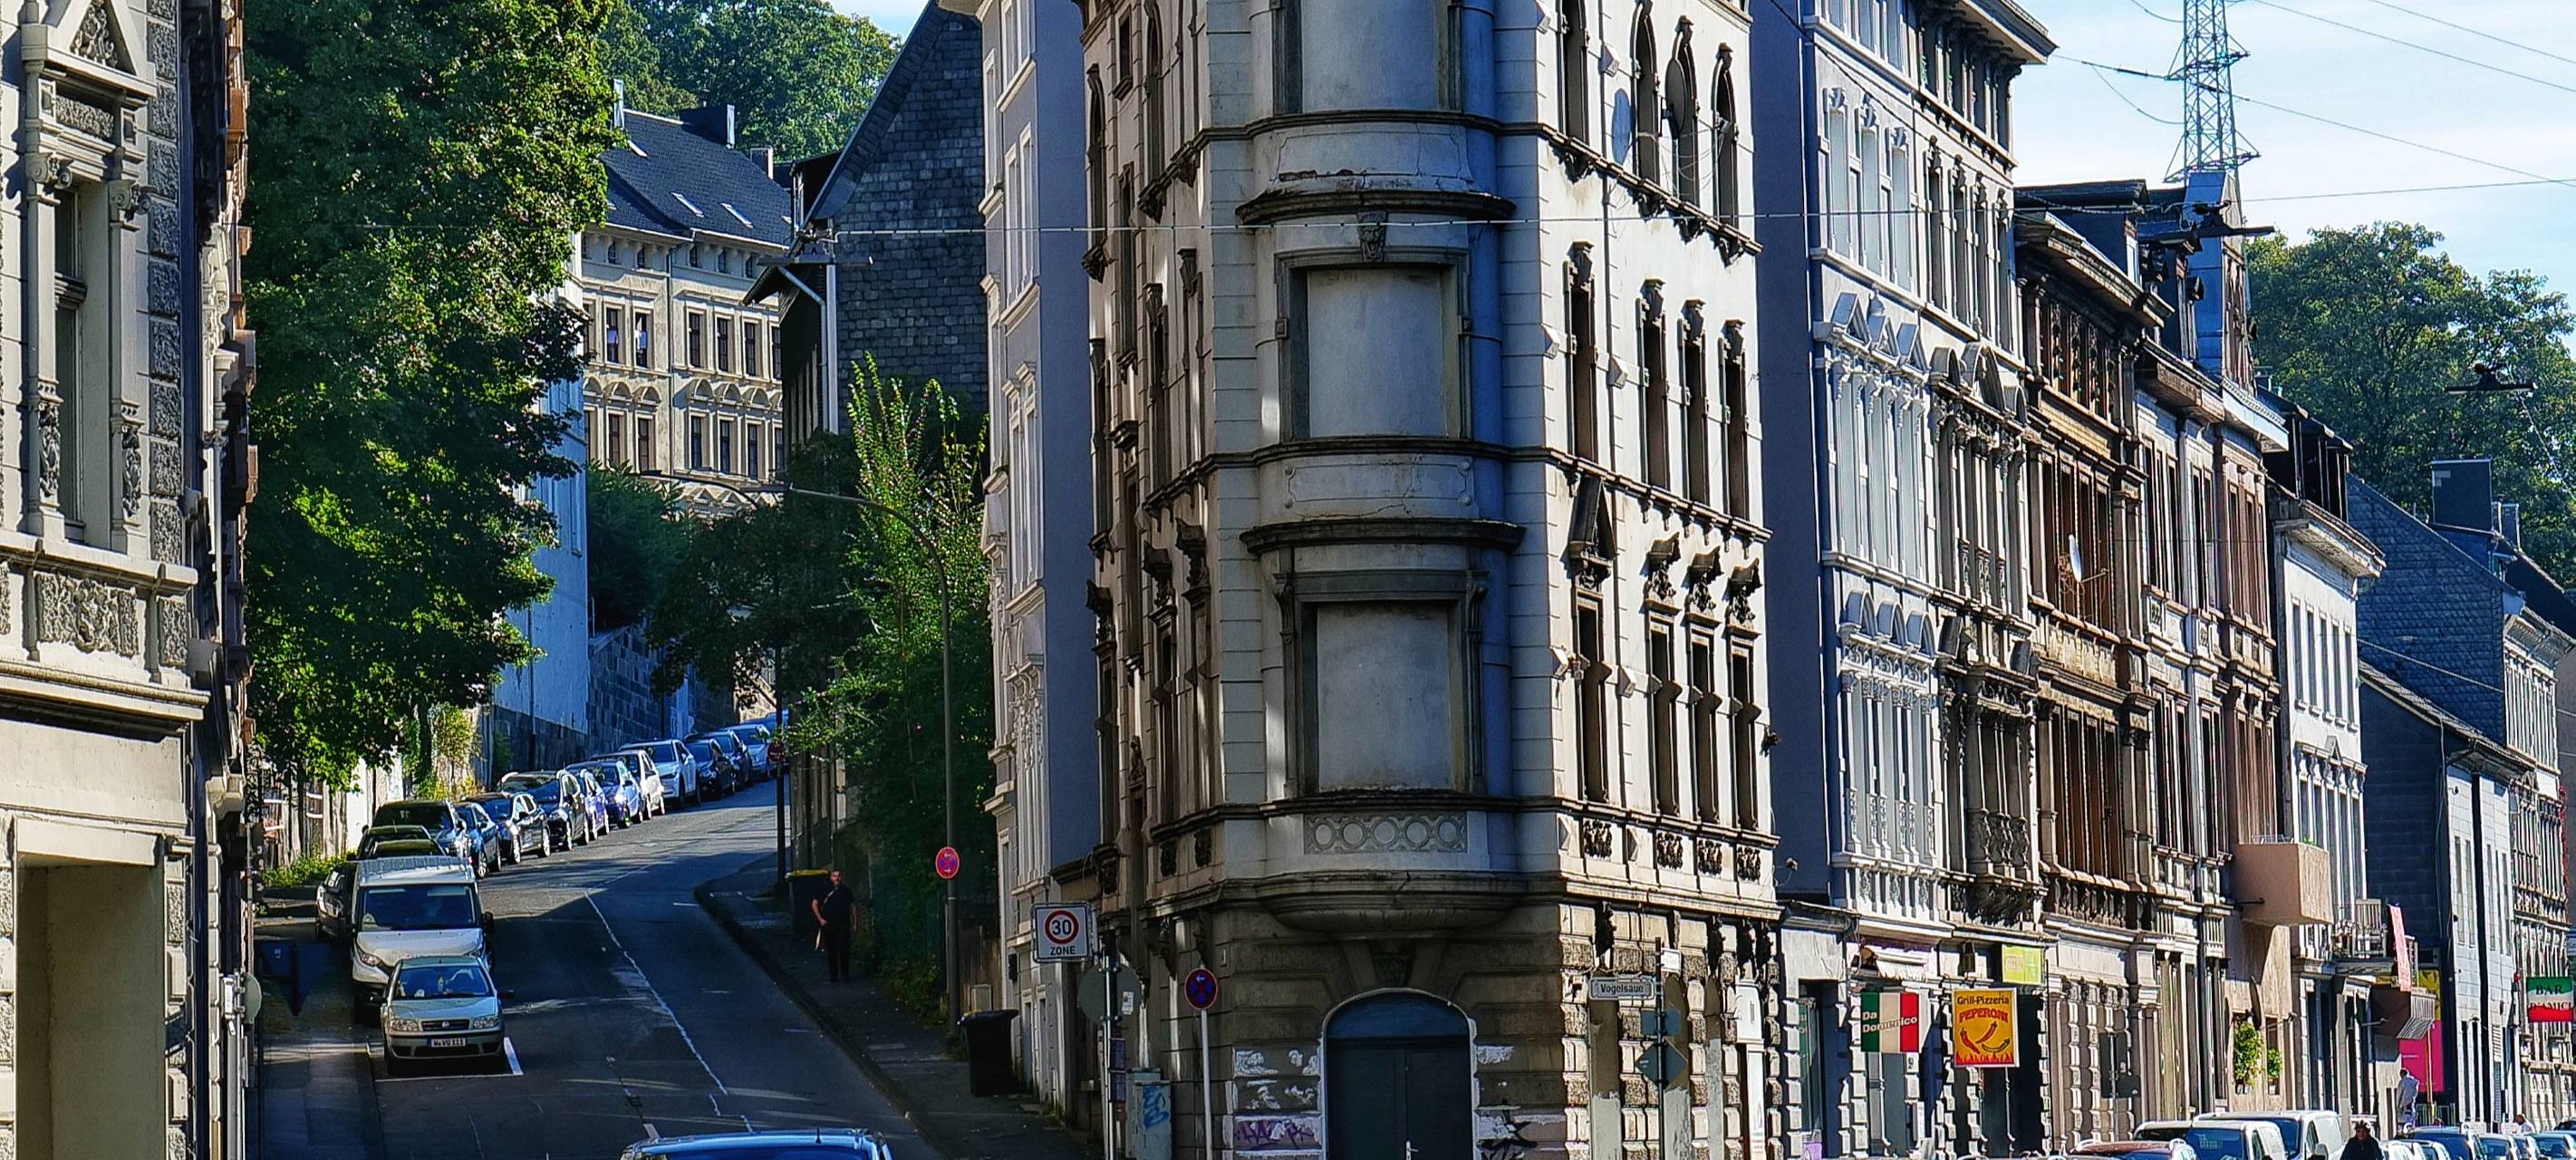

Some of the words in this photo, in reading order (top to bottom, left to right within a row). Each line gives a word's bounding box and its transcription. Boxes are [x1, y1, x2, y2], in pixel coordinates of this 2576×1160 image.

[1051, 920, 1072, 935] 30
[1049, 945, 1076, 956] ZONE
[1600, 983, 1645, 996] Vogelsaue
[2535, 984, 2564, 995] BAR
[1957, 995, 2010, 1005] Grill-Pizzeria
[1862, 1011, 1877, 1020] Da
[1959, 1007, 2009, 1023] PEPERONI
